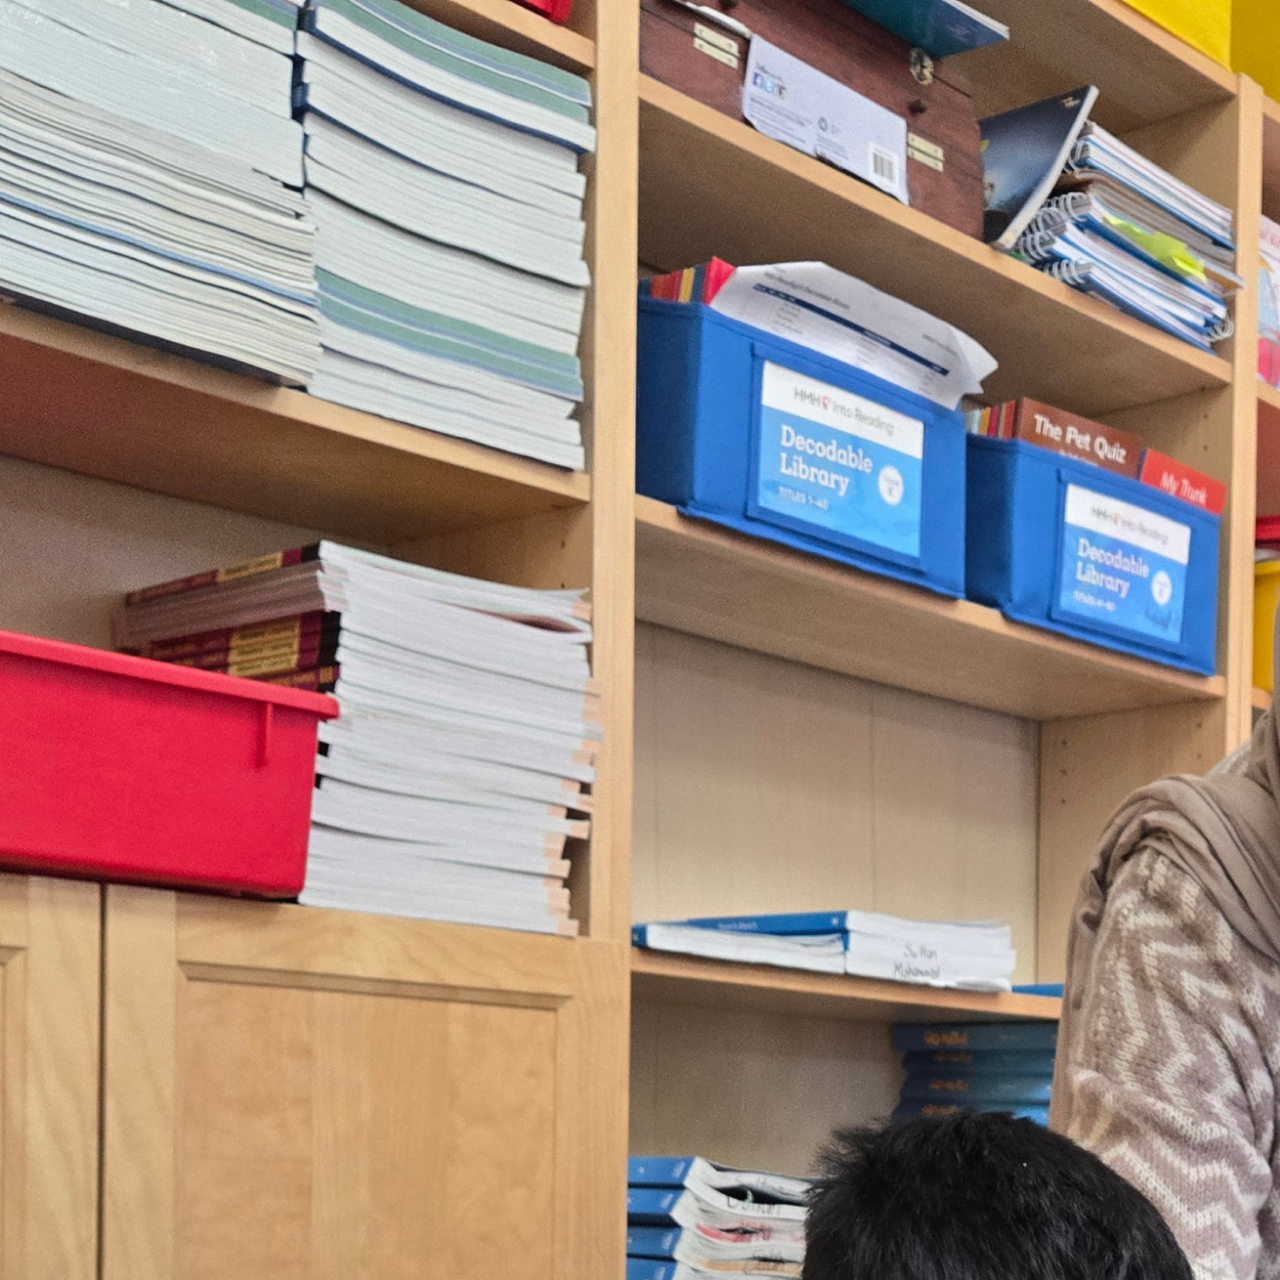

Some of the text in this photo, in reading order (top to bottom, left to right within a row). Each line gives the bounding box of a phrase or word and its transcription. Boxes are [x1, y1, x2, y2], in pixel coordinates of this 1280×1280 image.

[854, 408, 895, 437] Reading
[1033, 413, 1063, 442] The
[1065, 424, 1091, 452] Pet
[1093, 436, 1128, 464] Quiz
[780, 423, 874, 475] Decodable
[779, 452, 850, 498] Library
[1160, 471, 1209, 506] My Trunk
[1077, 537, 1150, 579] Decodable
[1076, 561, 1131, 599] Library
